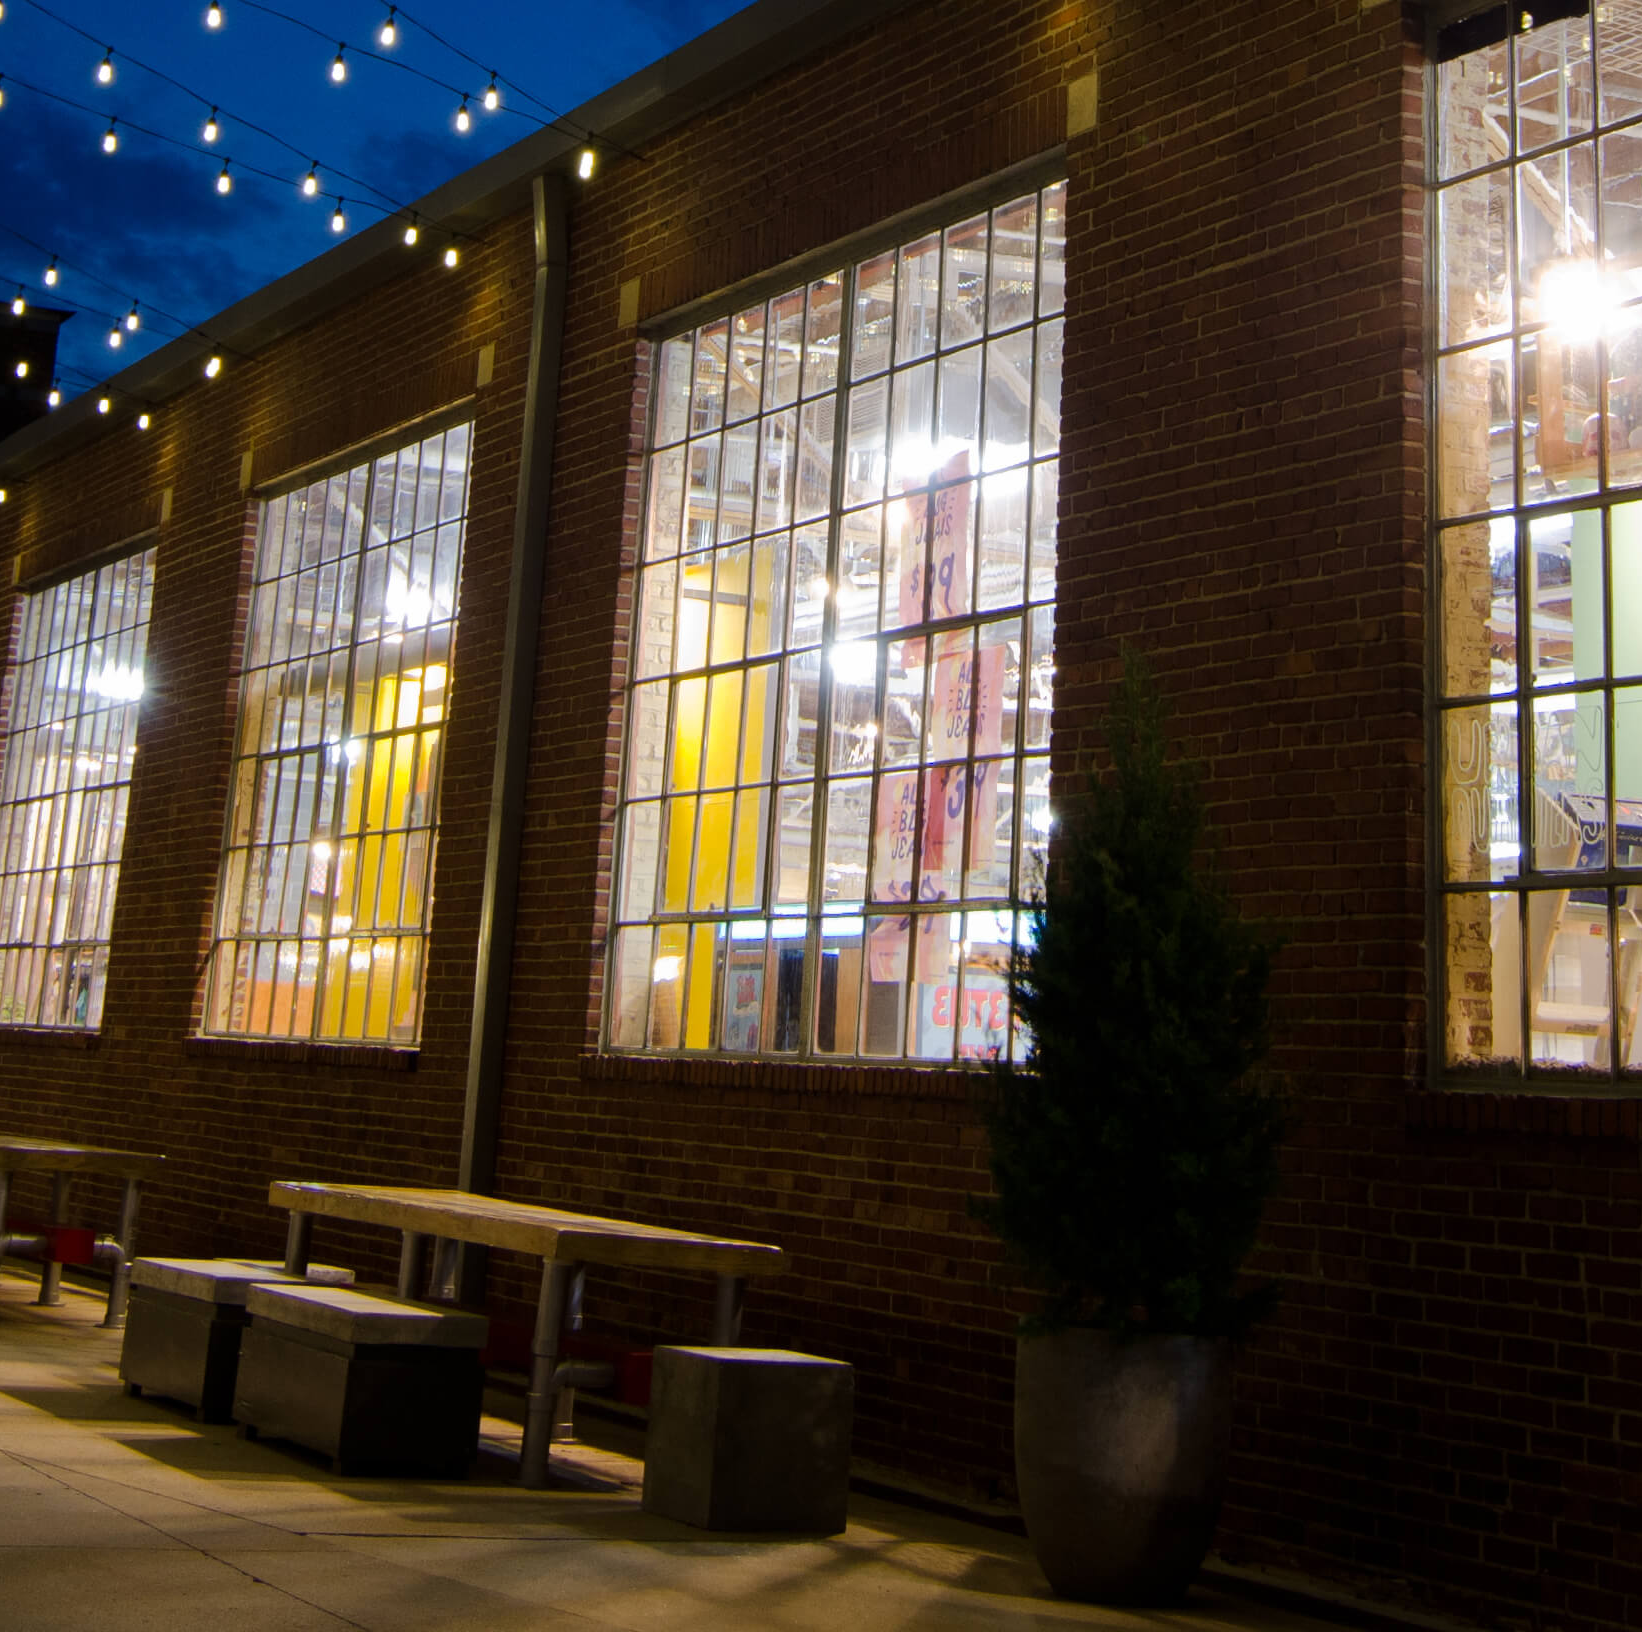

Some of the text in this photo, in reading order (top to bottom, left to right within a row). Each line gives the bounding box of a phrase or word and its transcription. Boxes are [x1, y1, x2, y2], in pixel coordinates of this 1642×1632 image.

[910, 552, 955, 615] $9
[957, 661, 981, 684] AL
[956, 688, 981, 712] BL
[947, 713, 985, 739] JEAS
[901, 783, 926, 805] AL
[899, 809, 926, 833] BL
[891, 836, 927, 861] JEA
